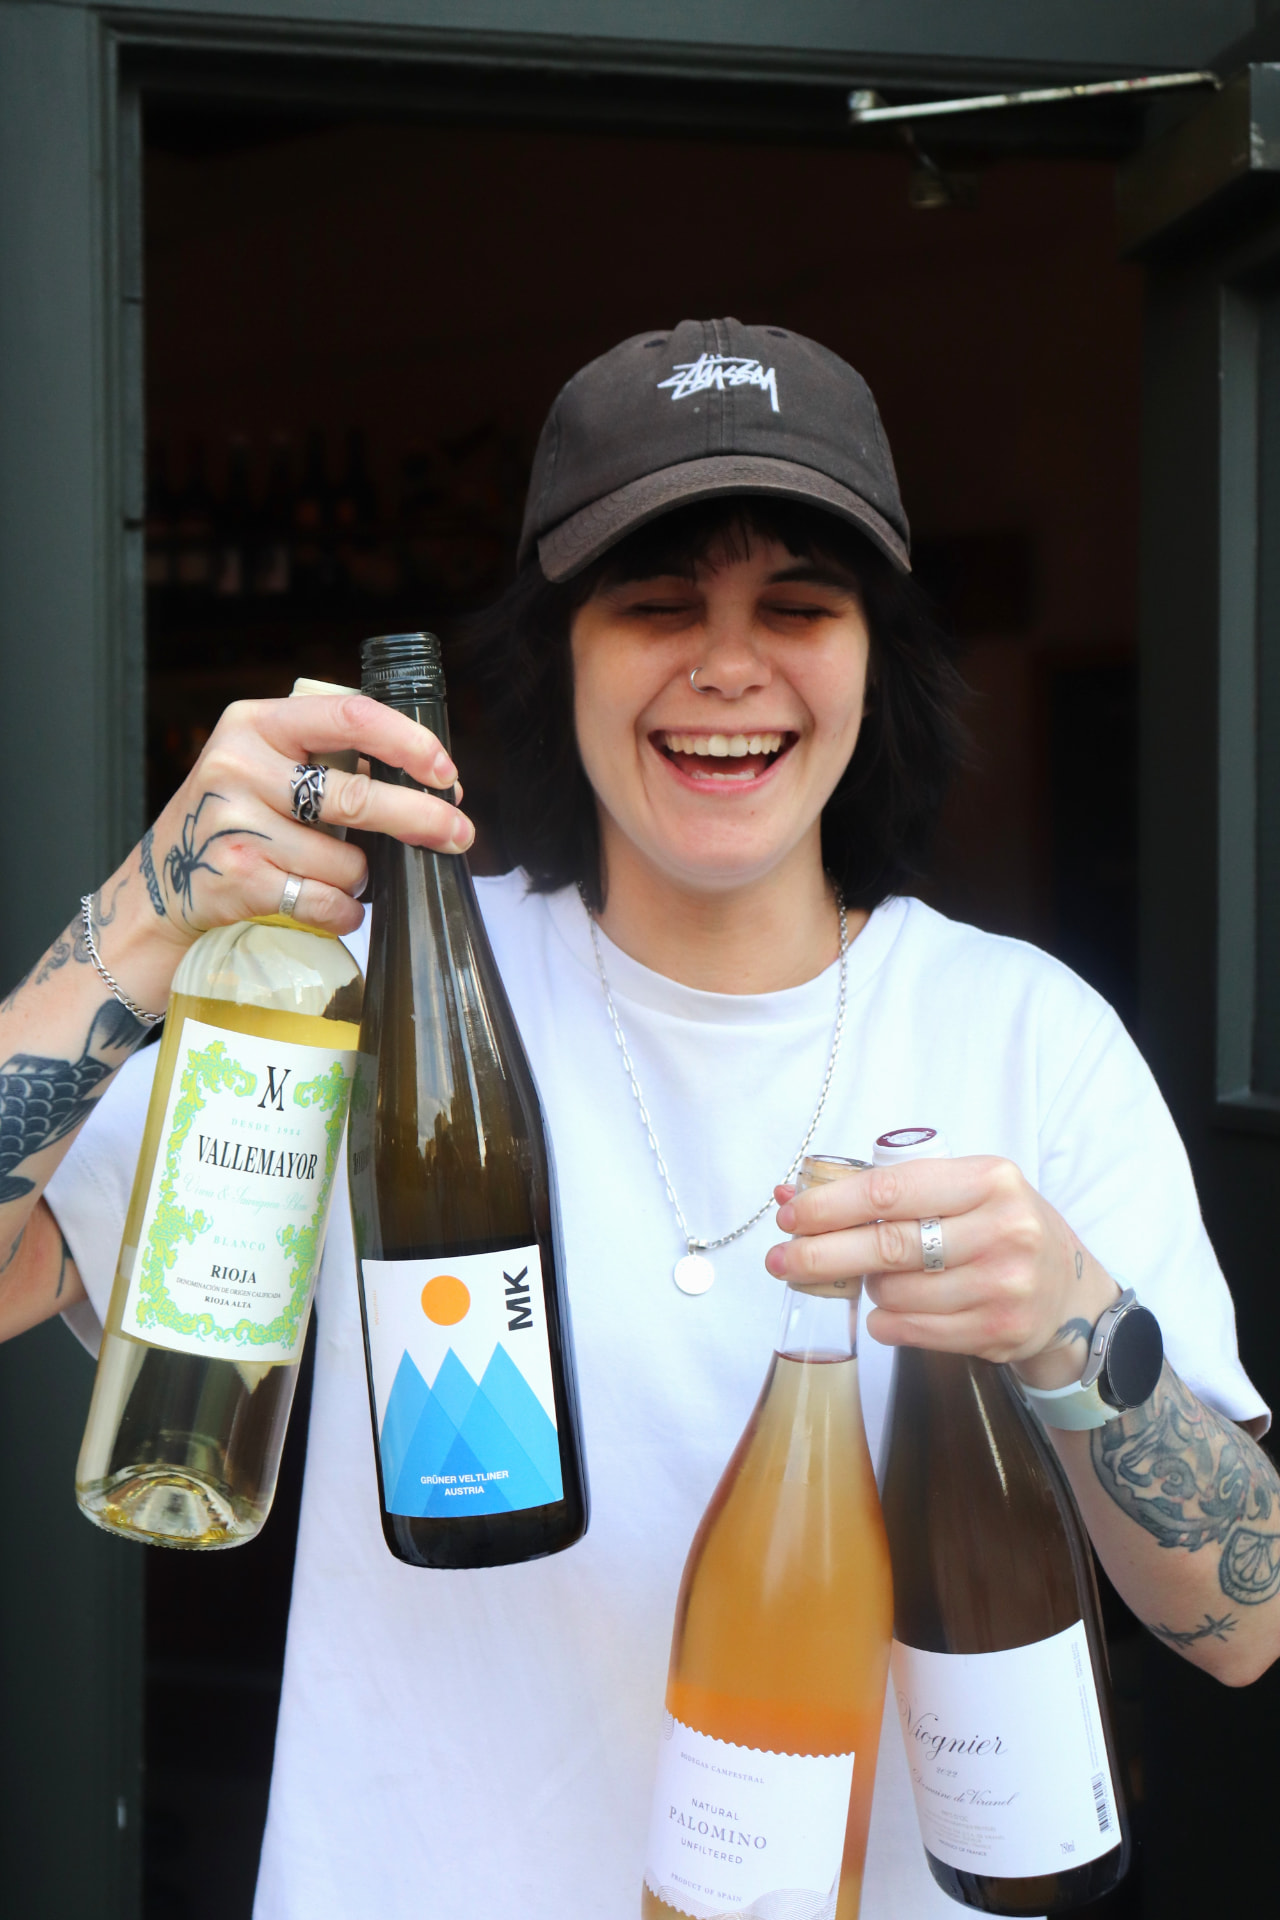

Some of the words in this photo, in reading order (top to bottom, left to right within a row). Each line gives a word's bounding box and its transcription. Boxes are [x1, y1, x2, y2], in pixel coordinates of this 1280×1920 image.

[231, 1118, 270, 1133] DESDE
[198, 1134, 318, 1180] VALLEMAYOR
[213, 1235, 266, 1252] BLANCO
[210, 1264, 257, 1284] RIOJA
[204, 1295, 229, 1306] RIOJA
[231, 1301, 252, 1309] ALTA
[503, 1265, 533, 1332] MK
[420, 1474, 457, 1485] GRÜNER
[458, 1470, 509, 1483] VELTLINER
[444, 1485, 485, 1496] AUSTRIA
[897, 1691, 1008, 1761] Viognier
[680, 1751, 709, 1769] BODEGAS
[711, 1765, 765, 1784] CAMPESTRAL
[691, 1798, 739, 1821] NATURAL
[668, 1805, 767, 1850] PALOMINO
[681, 1837, 743, 1865] UNFILTERED
[671, 1872, 702, 1891] PRODUCT
[704, 1887, 714, 1896] OF
[717, 1890, 742, 1903] SPAIN
